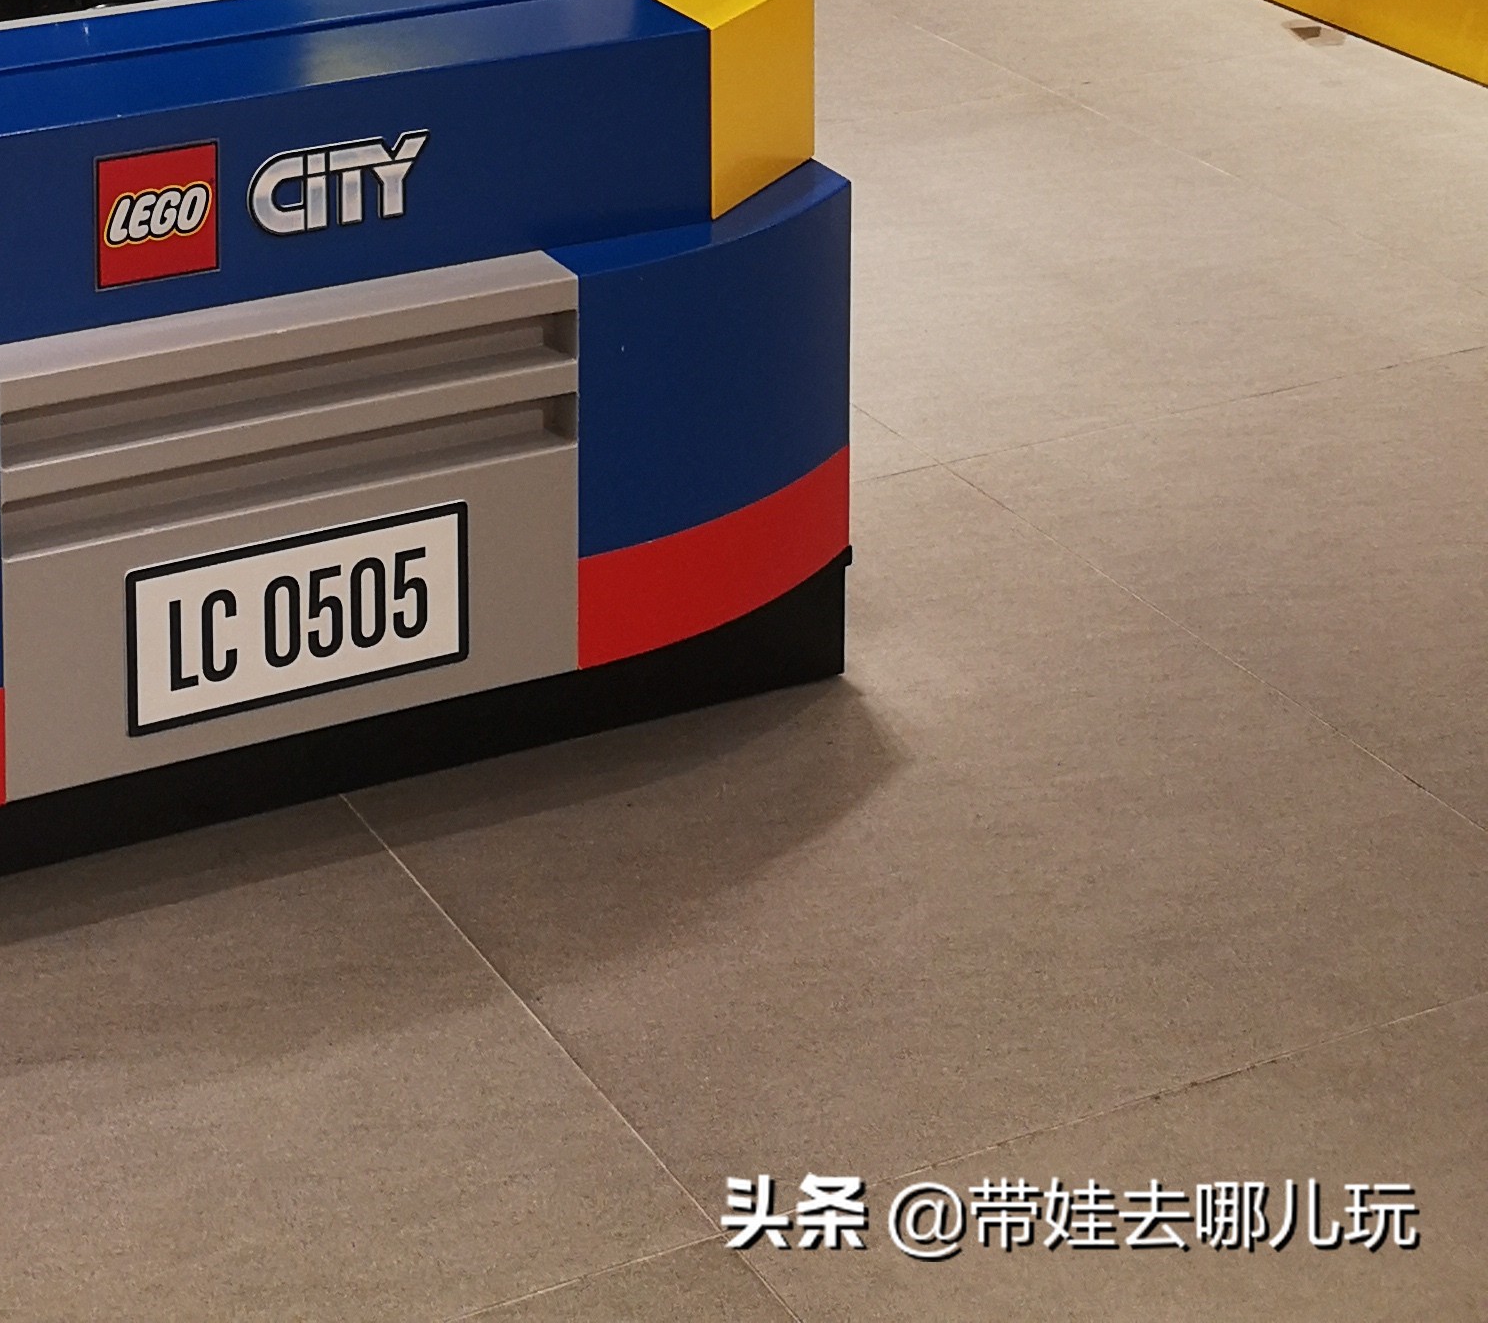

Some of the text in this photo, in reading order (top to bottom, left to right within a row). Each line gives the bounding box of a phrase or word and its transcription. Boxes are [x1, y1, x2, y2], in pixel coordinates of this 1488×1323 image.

[105, 183, 211, 246] LEGO
[168, 545, 429, 692] LC 0505
